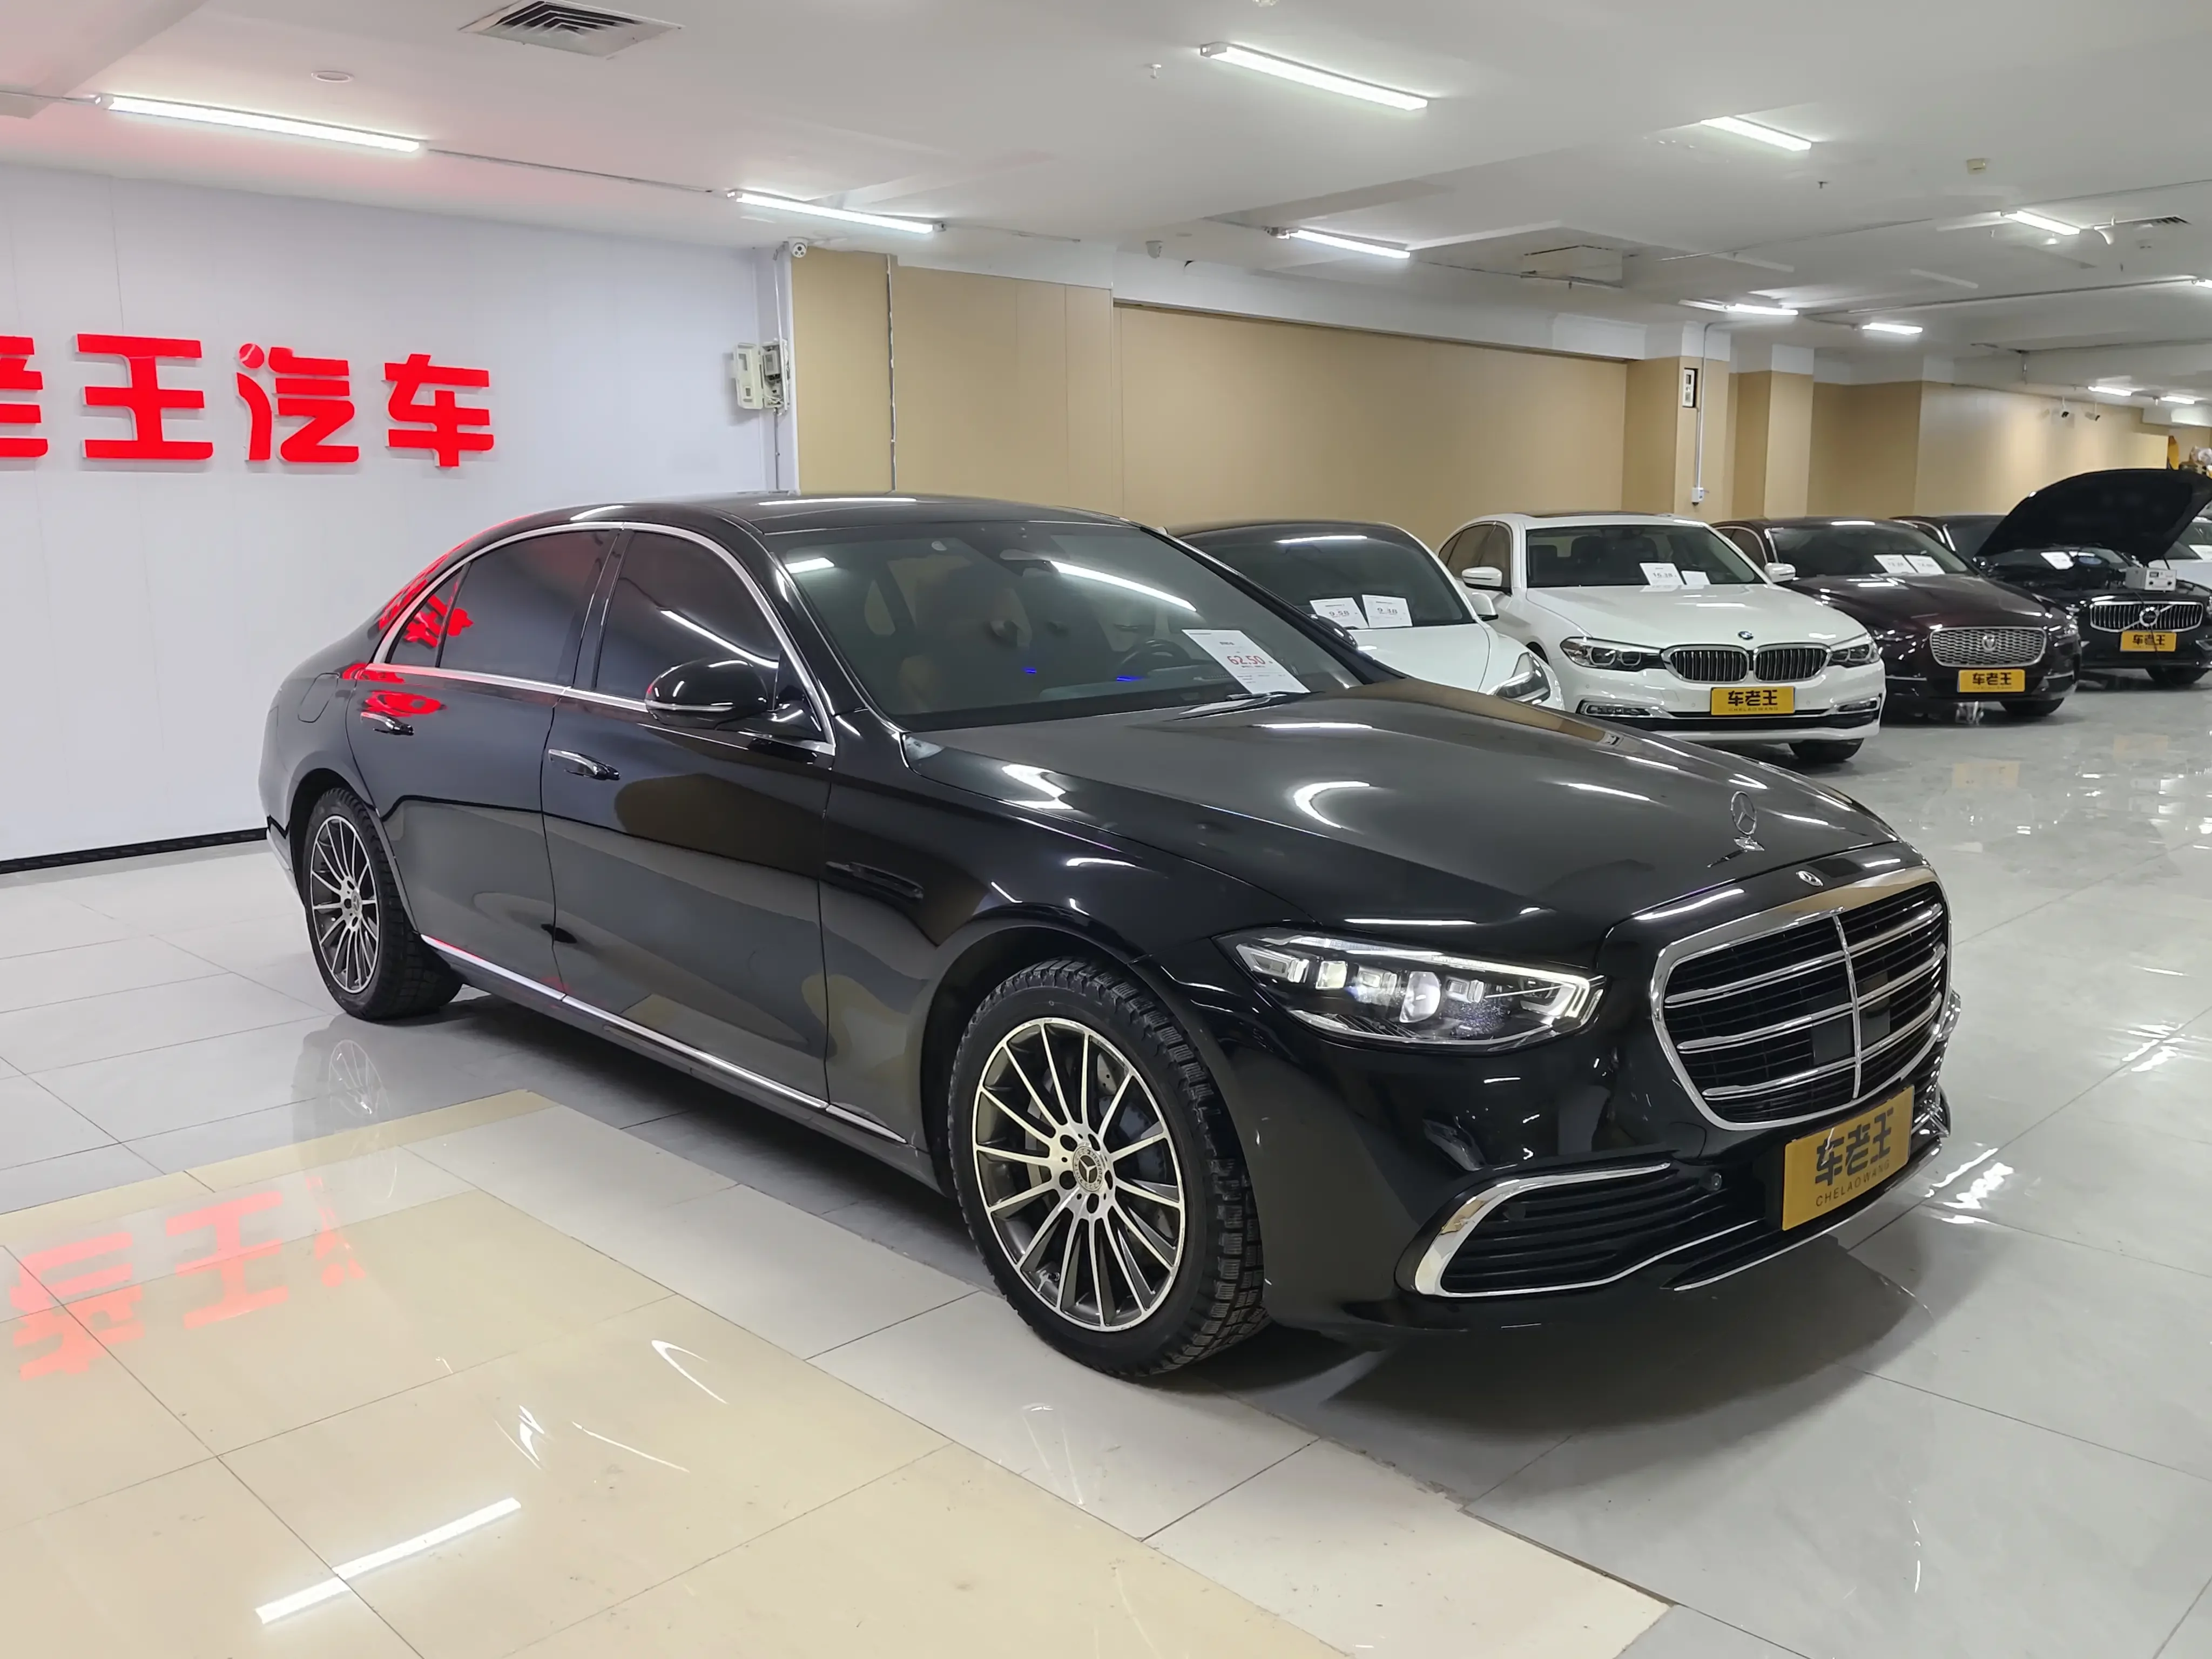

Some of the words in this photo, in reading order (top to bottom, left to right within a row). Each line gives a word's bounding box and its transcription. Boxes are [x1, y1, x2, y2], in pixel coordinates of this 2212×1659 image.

[1226, 655, 1266, 665] 62.50
[1972, 672, 2012, 685] 车老王
[1728, 689, 1778, 706] 车老王
[1815, 1107, 1894, 1186] 车老王
[1816, 1159, 1890, 1206] CHELAOWANG
